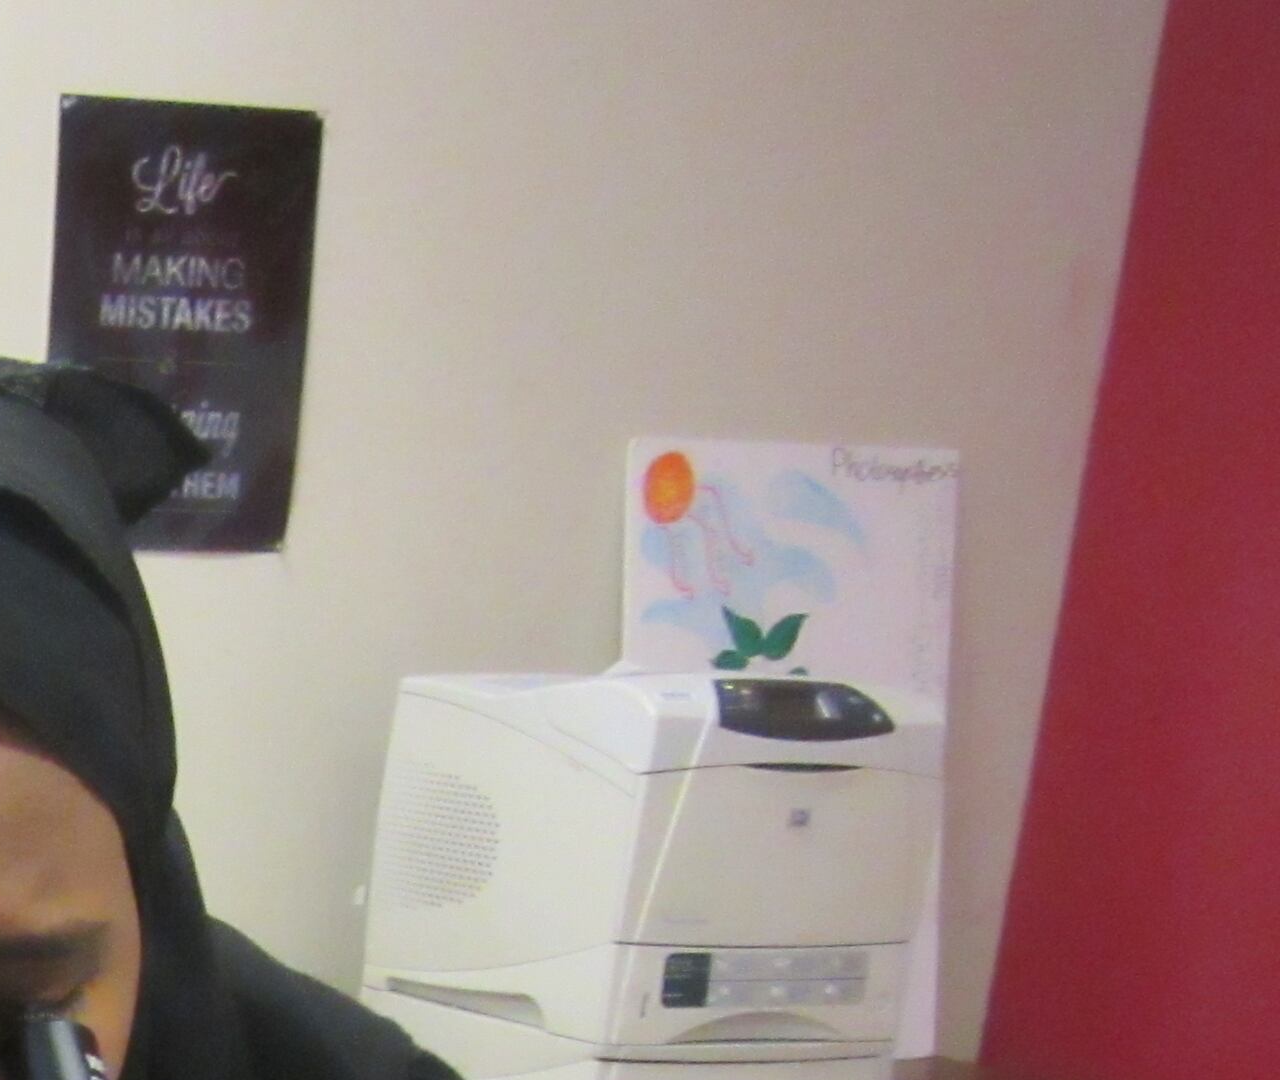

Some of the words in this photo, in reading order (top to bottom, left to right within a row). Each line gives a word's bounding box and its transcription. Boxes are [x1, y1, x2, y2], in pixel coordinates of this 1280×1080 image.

[131, 144, 238, 215] Life
[111, 252, 246, 290] MAKING
[176, 400, 240, 457] ning
[171, 471, 241, 499] HEM
